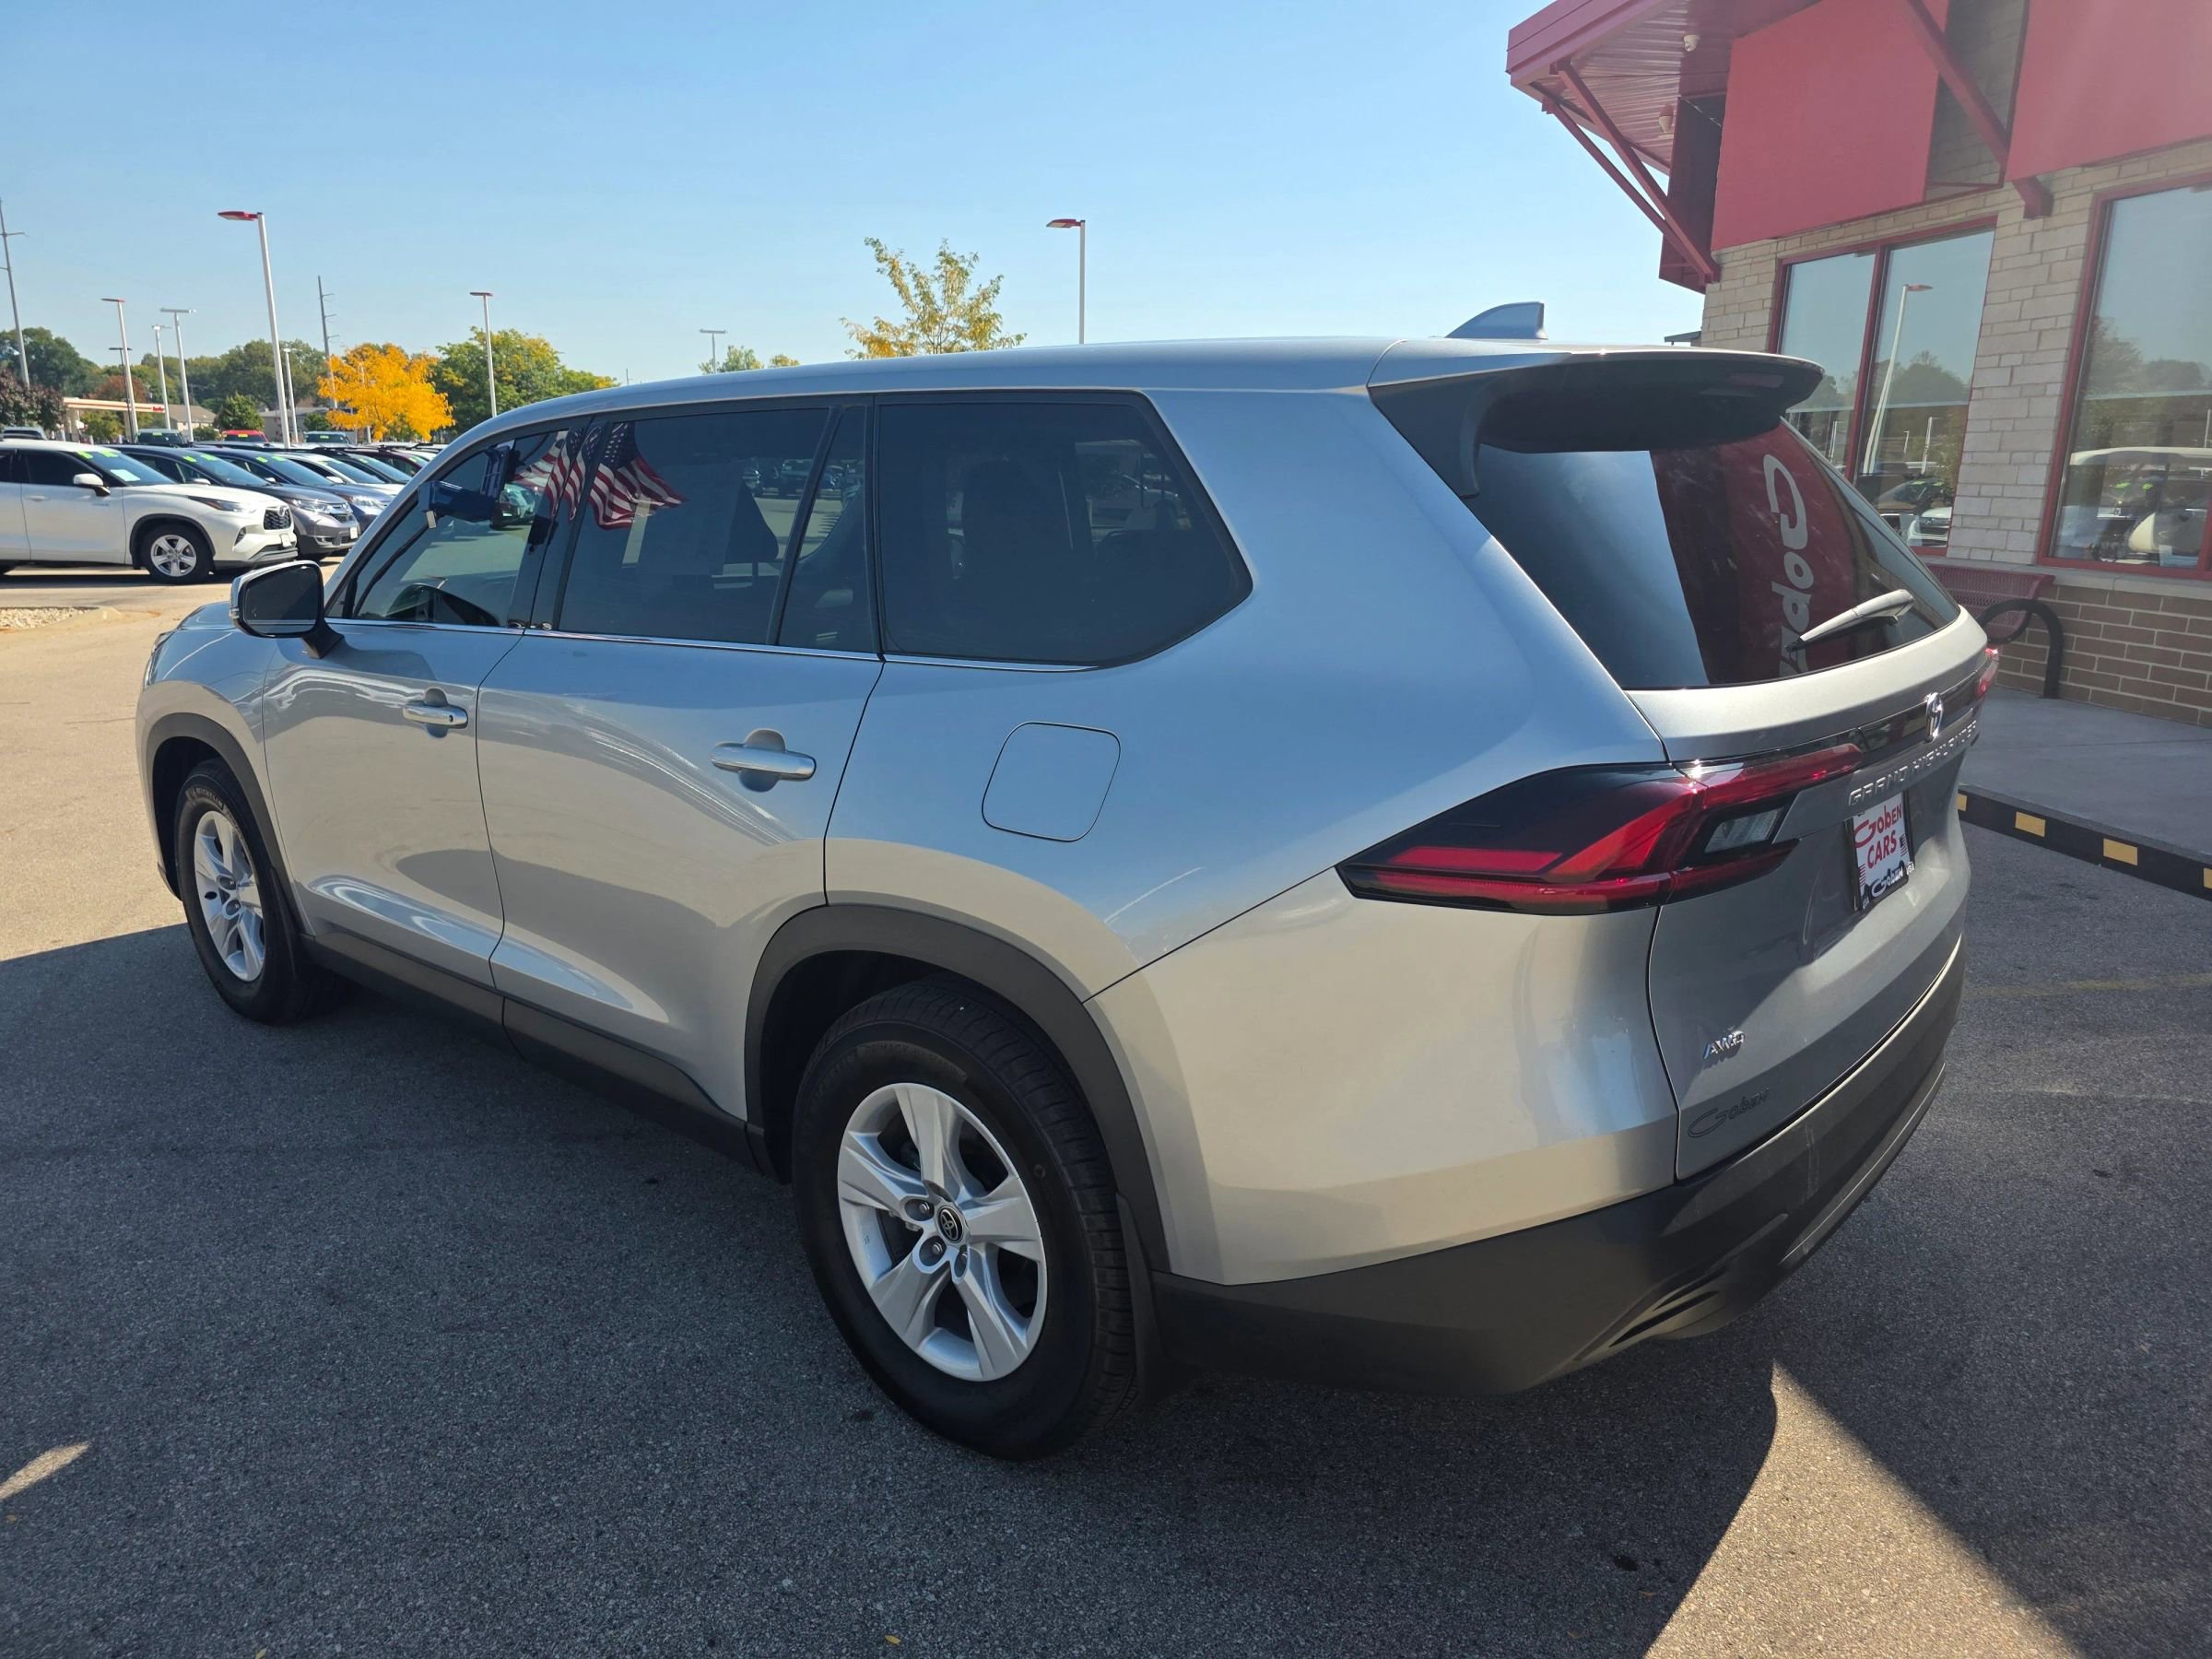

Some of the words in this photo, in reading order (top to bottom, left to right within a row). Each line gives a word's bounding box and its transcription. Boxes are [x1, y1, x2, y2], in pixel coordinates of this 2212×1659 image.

[1848, 766, 1908, 807] GRAND
[1867, 830, 1897, 869] CARS
[1702, 1030, 1746, 1060] AWD
